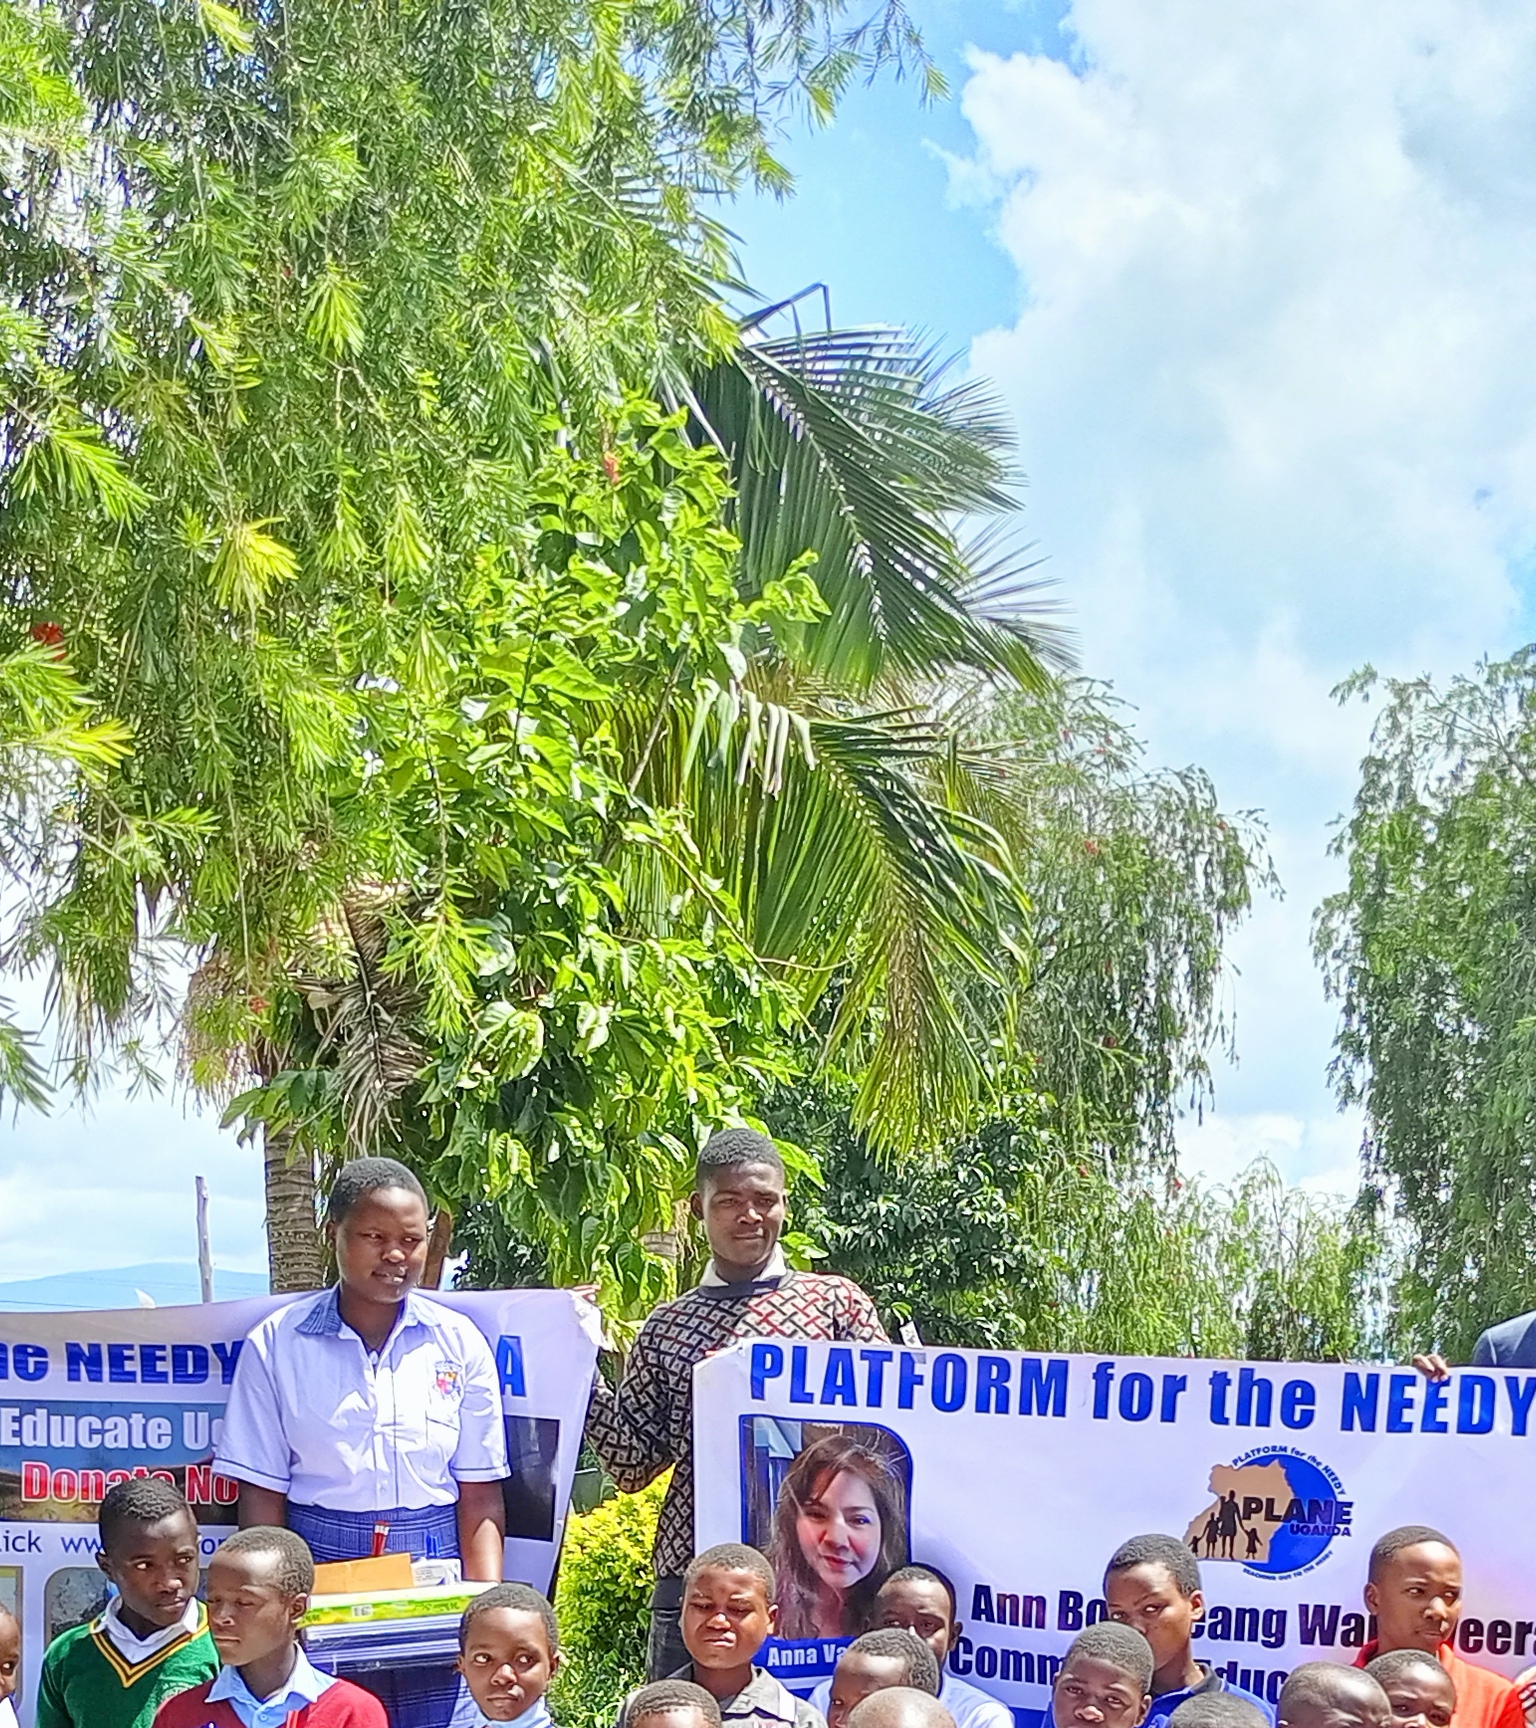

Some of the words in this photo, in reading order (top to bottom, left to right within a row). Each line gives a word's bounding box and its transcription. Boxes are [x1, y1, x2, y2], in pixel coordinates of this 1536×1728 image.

[67, 1339, 244, 1385] NEEDY
[750, 1344, 1069, 1418] PLATFORM
[1091, 1362, 1188, 1423] for
[1209, 1367, 1316, 1430] the
[0, 1406, 173, 1450] Educate
[21, 1461, 175, 1503] Don
[1232, 1445, 1288, 1466] PLATFORM
[1291, 1447, 1306, 1457] for
[1307, 1455, 1322, 1468] the
[1322, 1466, 1346, 1496] NEEDY
[1242, 1496, 1354, 1525] PLANE
[1289, 1523, 1351, 1537] UGANDA
[971, 1584, 1047, 1630] Ann
[767, 1646, 817, 1666] Anna
